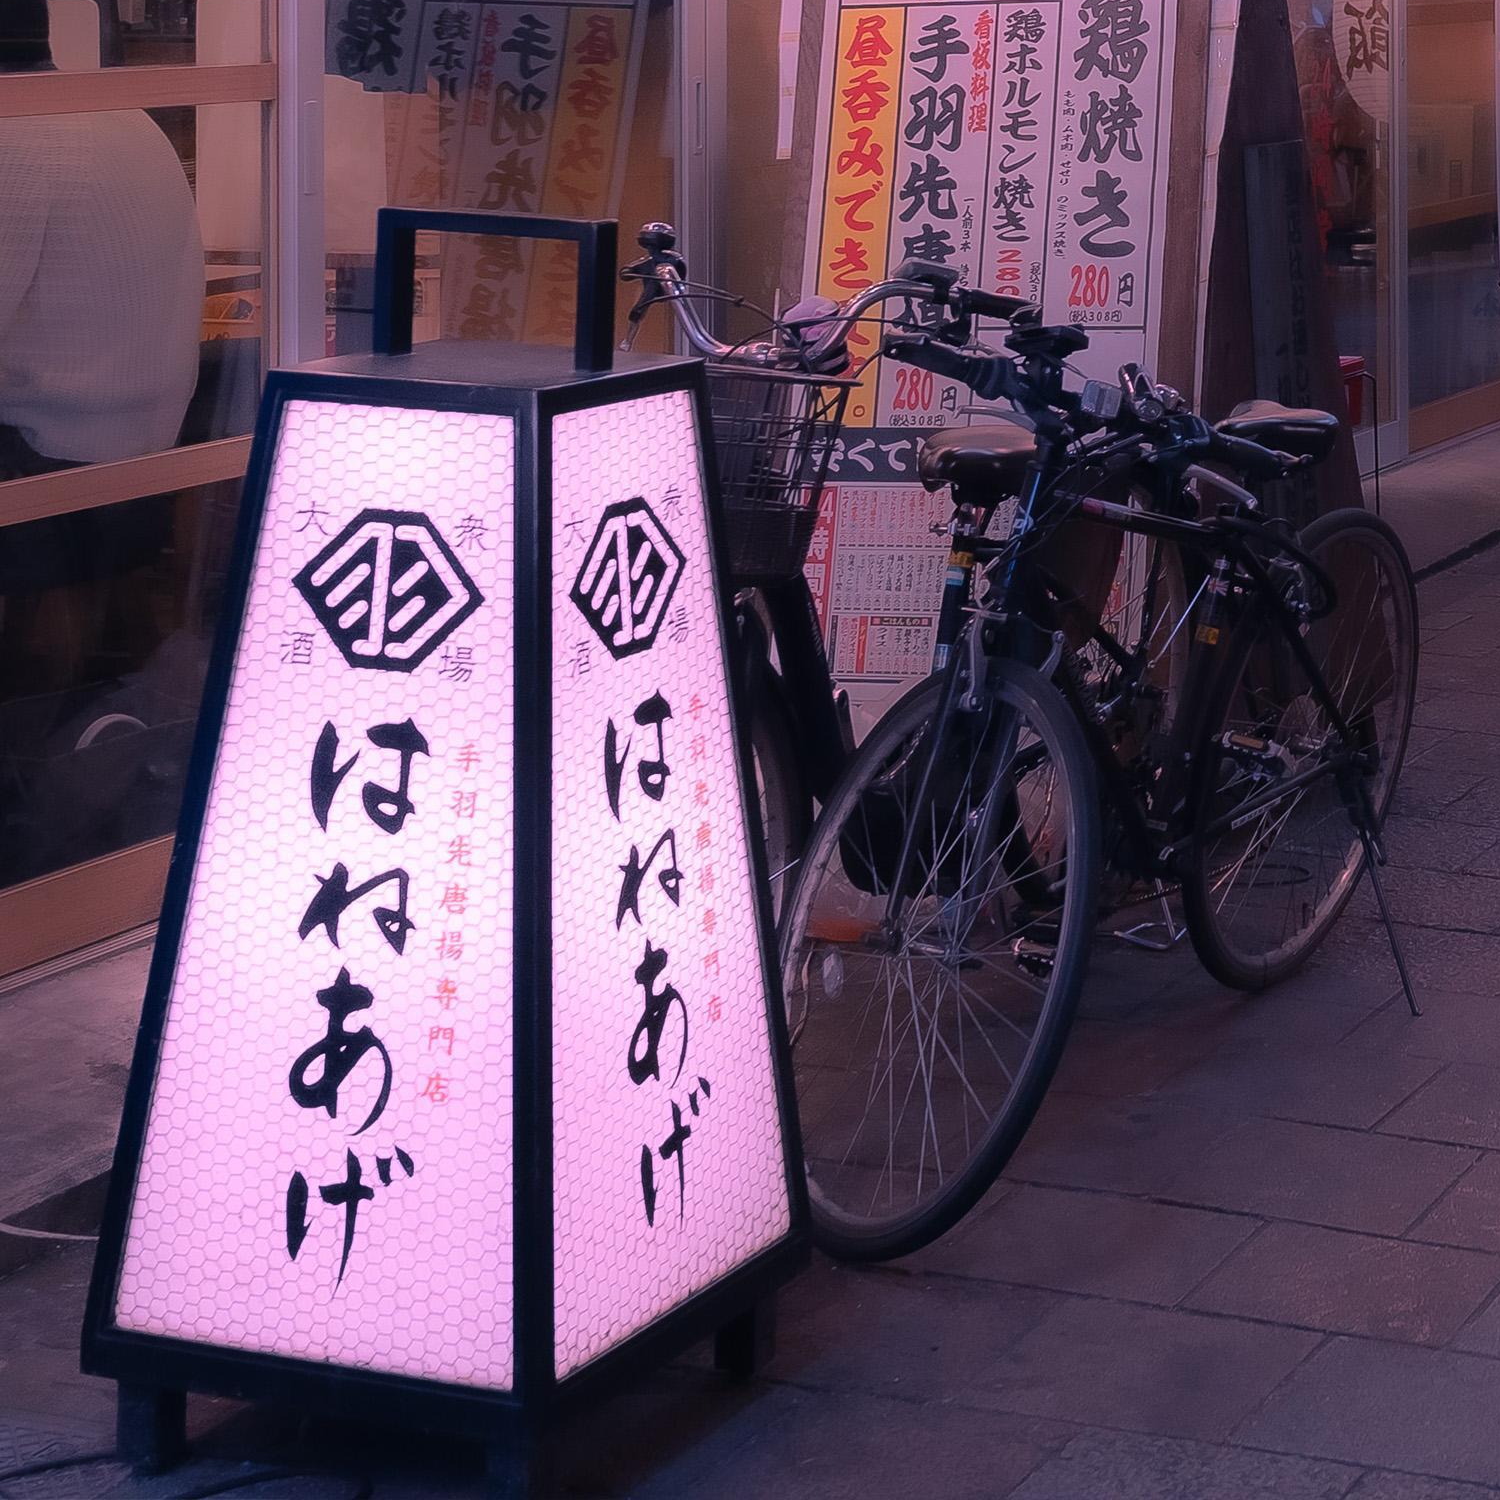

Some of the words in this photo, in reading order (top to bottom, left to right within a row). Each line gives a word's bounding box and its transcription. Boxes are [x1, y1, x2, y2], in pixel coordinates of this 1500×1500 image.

[967, 10, 993, 134] 看板料理
[992, 9, 1046, 242] 鶏ホルモン焼き
[286, 717, 430, 1299] はねあげ
[604, 689, 710, 1228] はねあげ
